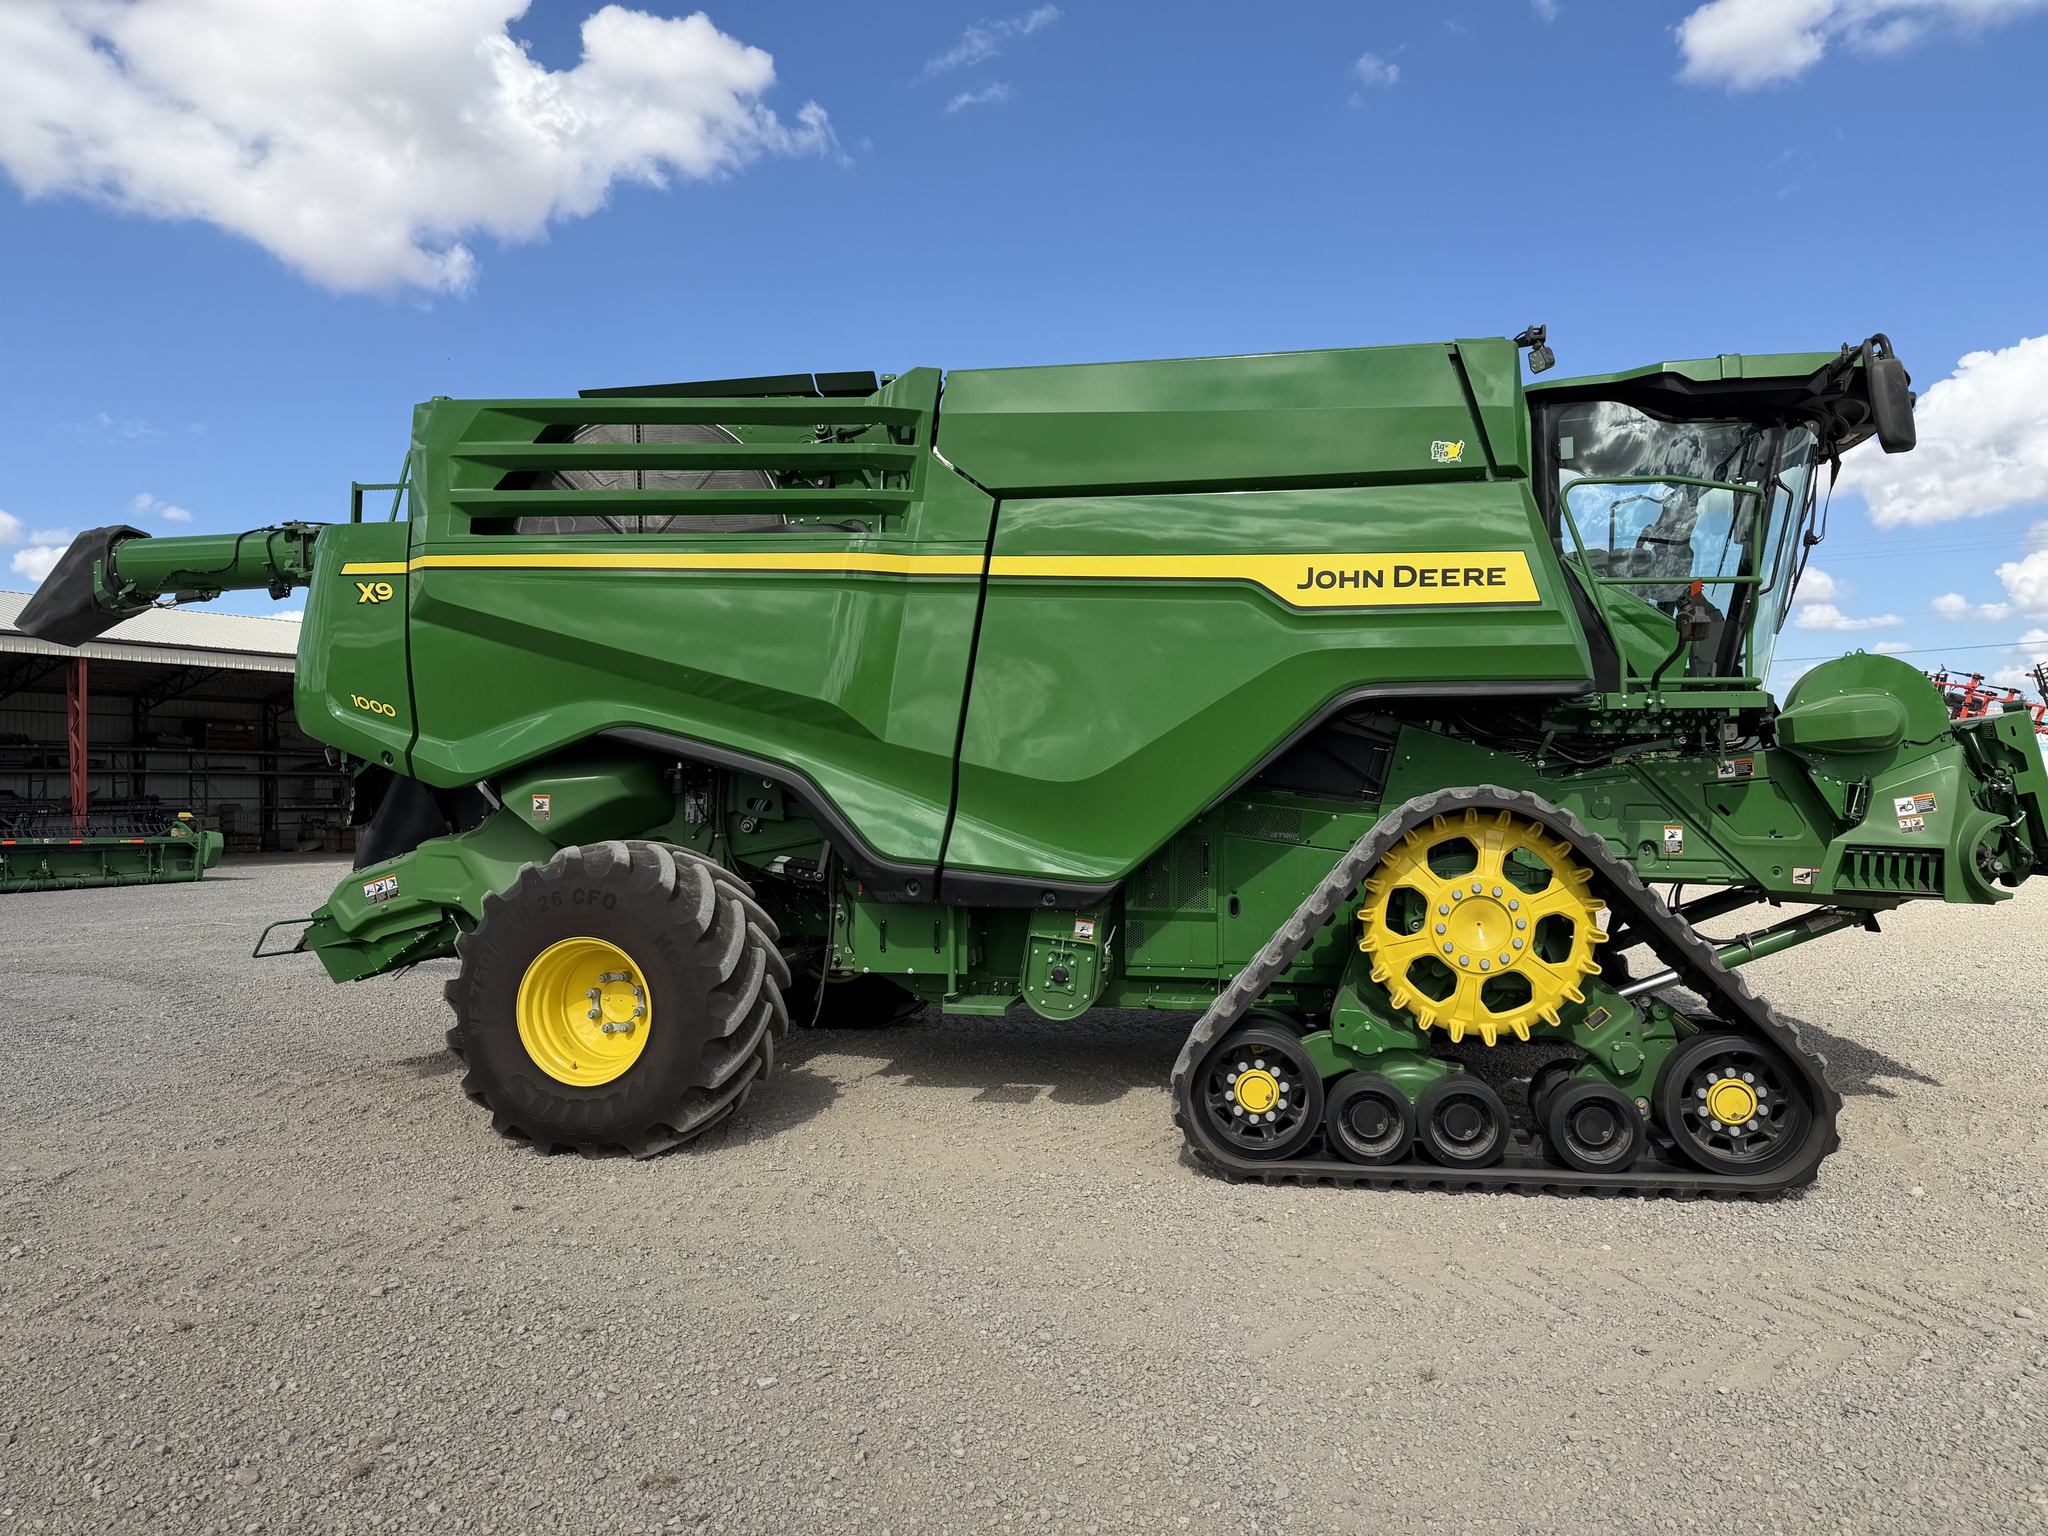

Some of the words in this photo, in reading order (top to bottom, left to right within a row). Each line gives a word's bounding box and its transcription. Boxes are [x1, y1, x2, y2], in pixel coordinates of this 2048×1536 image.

[1296, 567, 1384, 589] JOHN
[1393, 565, 1506, 588] DEERE
[354, 582, 394, 604] X9
[350, 693, 397, 717] 1000
[468, 1003, 485, 1036] VF
[536, 889, 564, 913] 26
[571, 886, 618, 912] CFO
